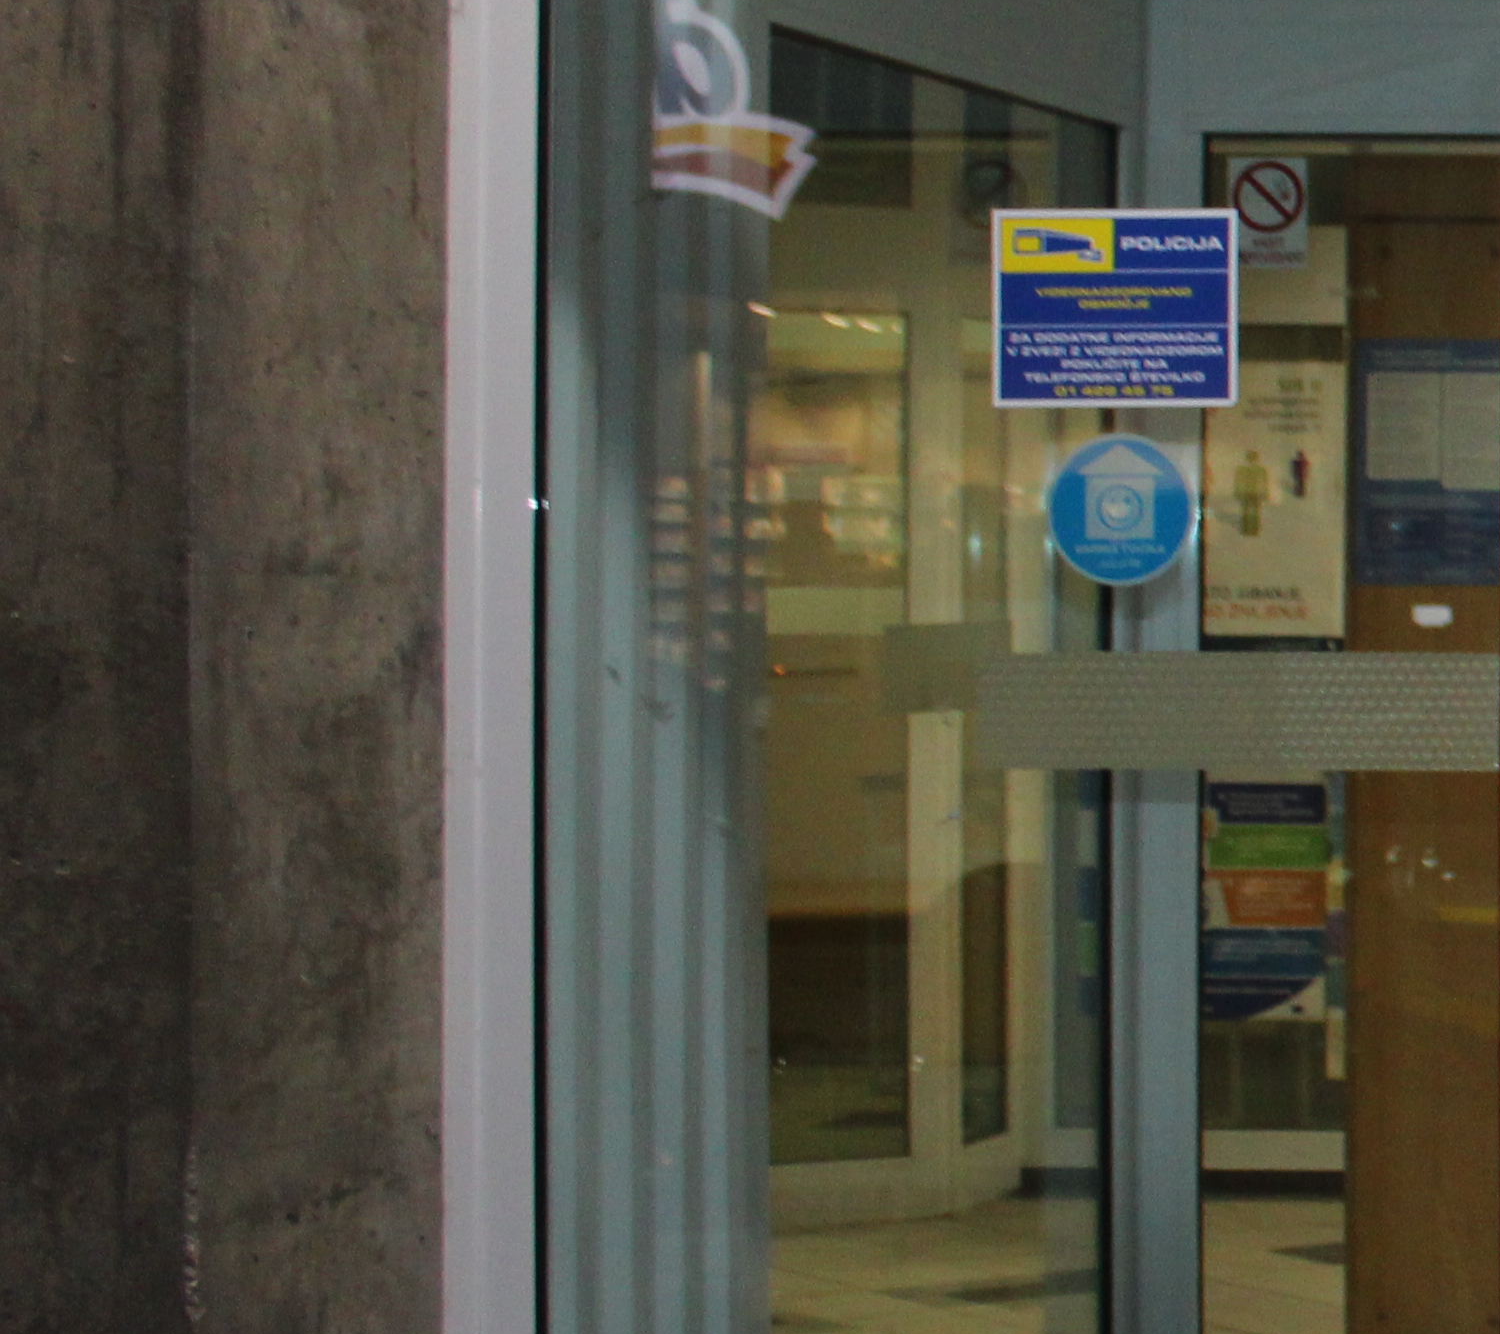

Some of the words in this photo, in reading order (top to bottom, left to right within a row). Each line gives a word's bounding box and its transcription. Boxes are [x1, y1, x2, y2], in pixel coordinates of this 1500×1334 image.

[1120, 235, 1224, 252] POLICIJA
[1112, 332, 1220, 344] INFORMACIJE
[1142, 358, 1169, 370] NA
[1023, 371, 1127, 383] TELEFONSKO
